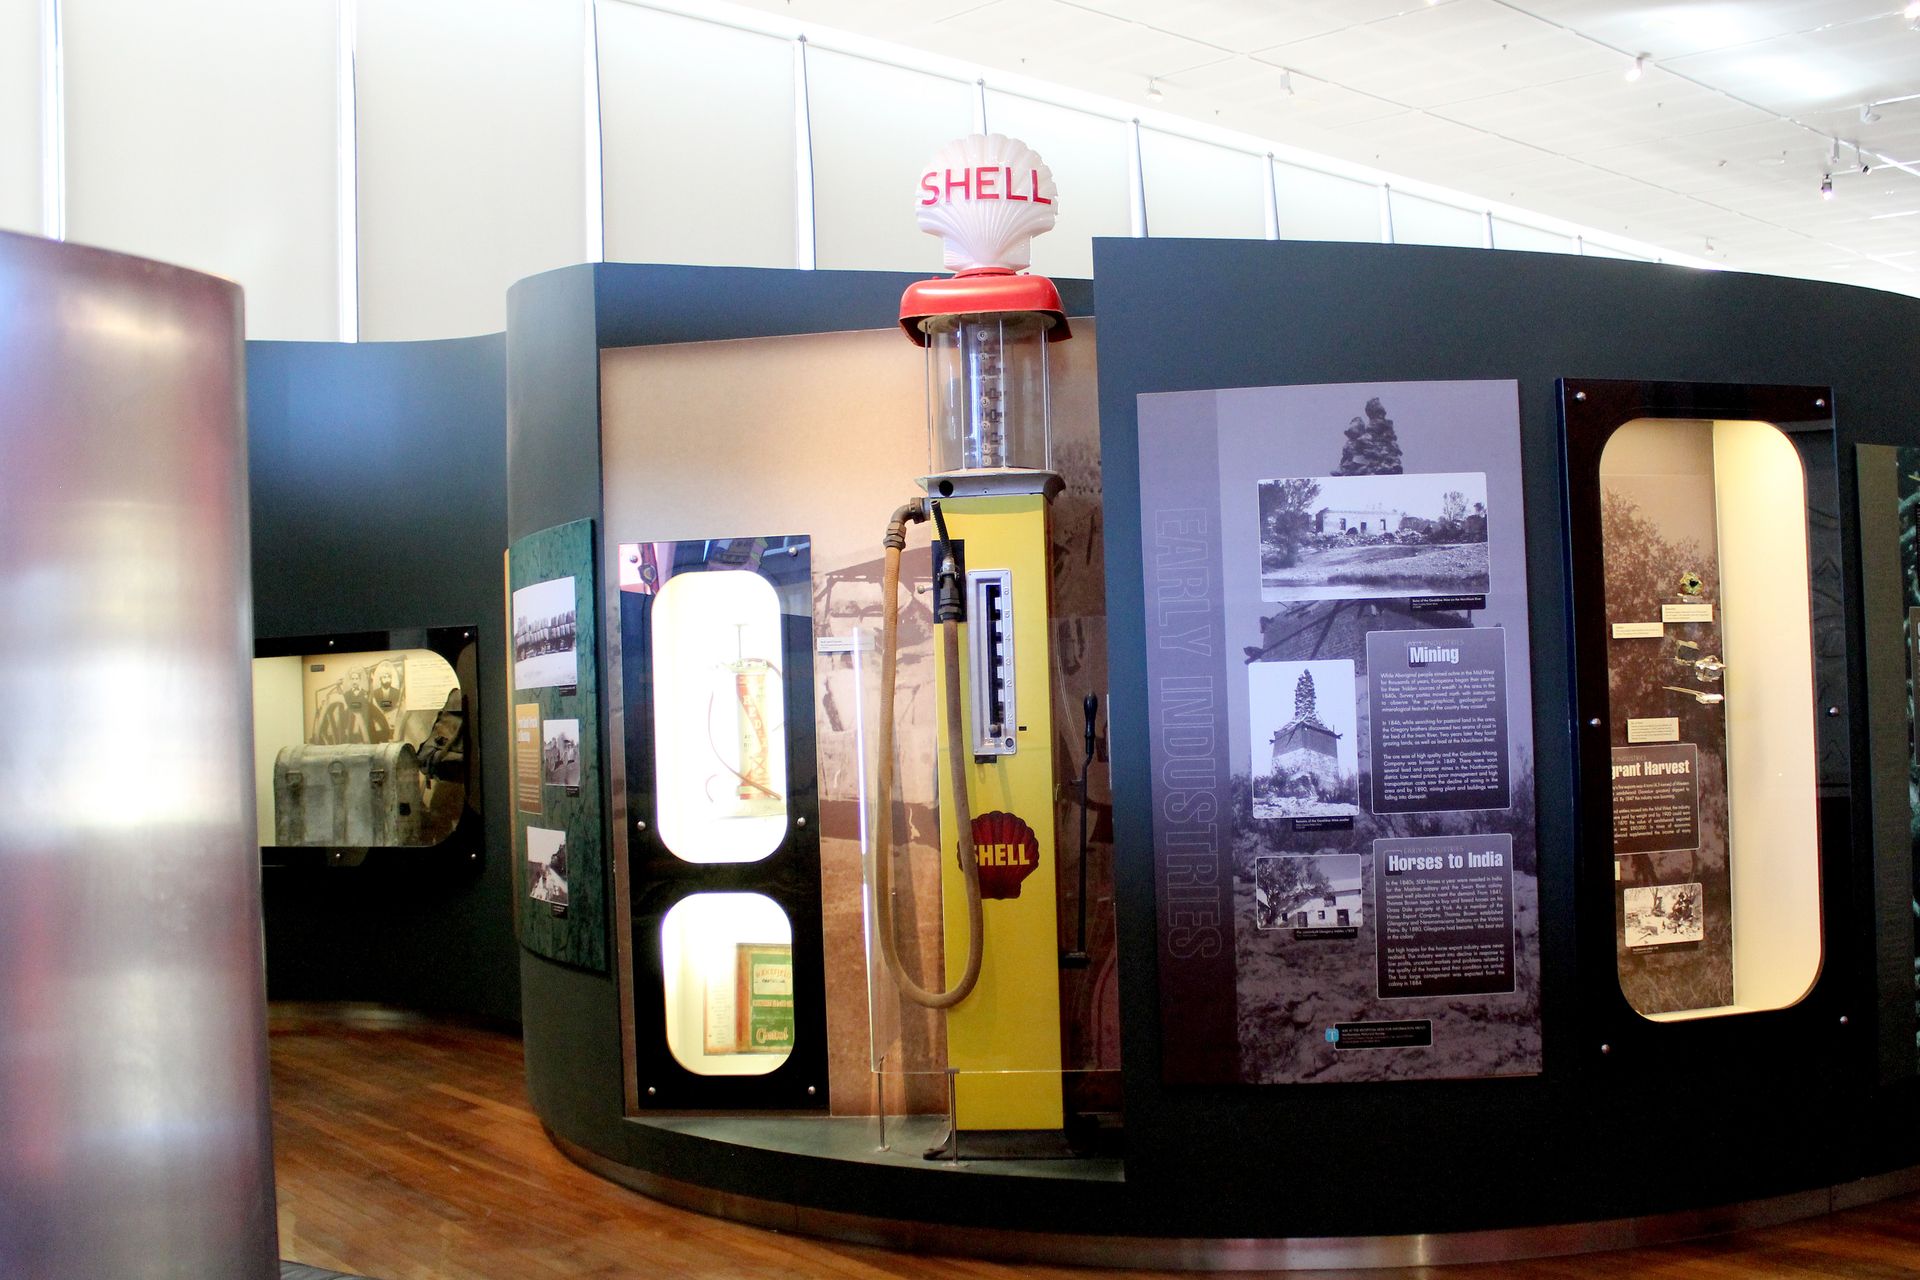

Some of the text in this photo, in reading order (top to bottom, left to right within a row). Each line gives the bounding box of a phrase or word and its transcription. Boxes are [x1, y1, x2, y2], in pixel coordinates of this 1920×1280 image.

[921, 167, 1051, 205] SHELL
[1409, 646, 1459, 664] Mining
[1155, 508, 1222, 958] EARLY INDUSTRIES
[1644, 760, 1690, 776] Harvest
[974, 843, 1030, 866] HELL
[1388, 851, 1504, 872] Horses to India
